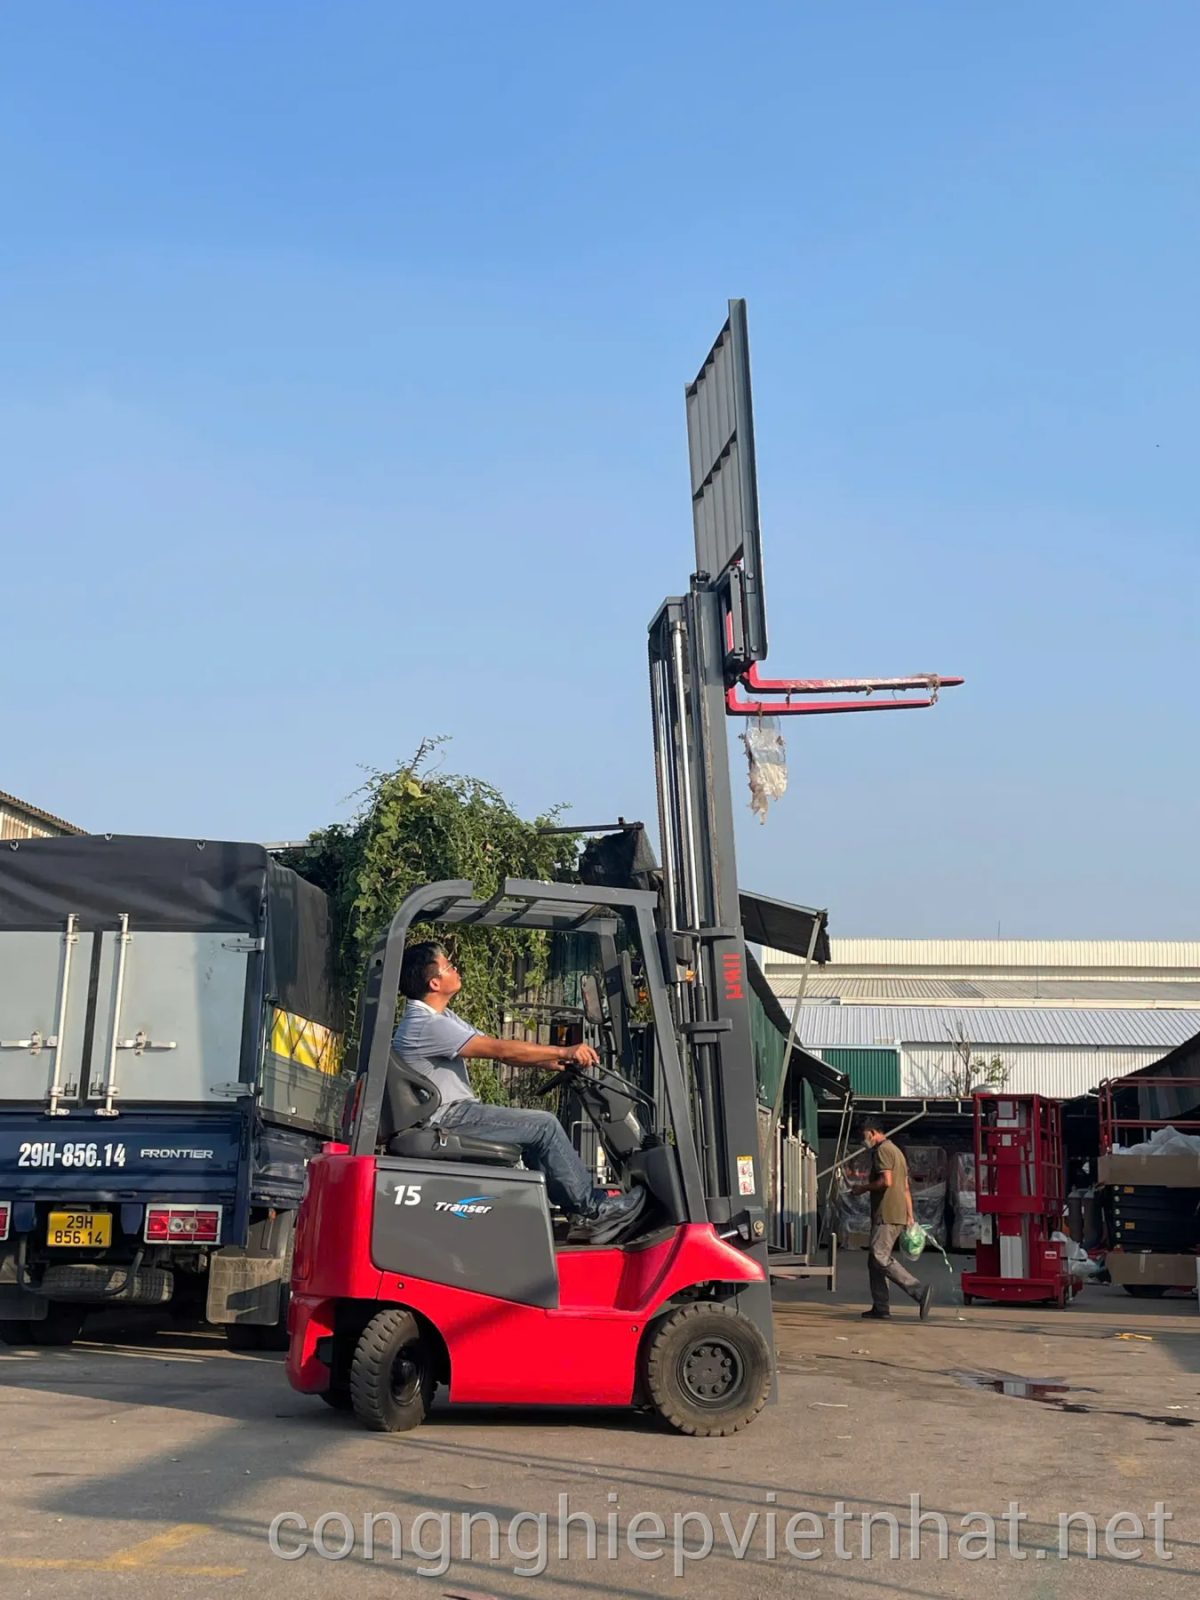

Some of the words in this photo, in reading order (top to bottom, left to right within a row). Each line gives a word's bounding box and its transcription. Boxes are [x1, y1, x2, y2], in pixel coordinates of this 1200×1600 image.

[18, 1142, 126, 1167] 29H-856.14
[140, 1149, 213, 1159] FRONTIER
[394, 1185, 422, 1206] 15
[435, 1201, 492, 1214] Transer
[66, 1215, 93, 1229] 29H
[54, 1231, 103, 1245] 856.14
